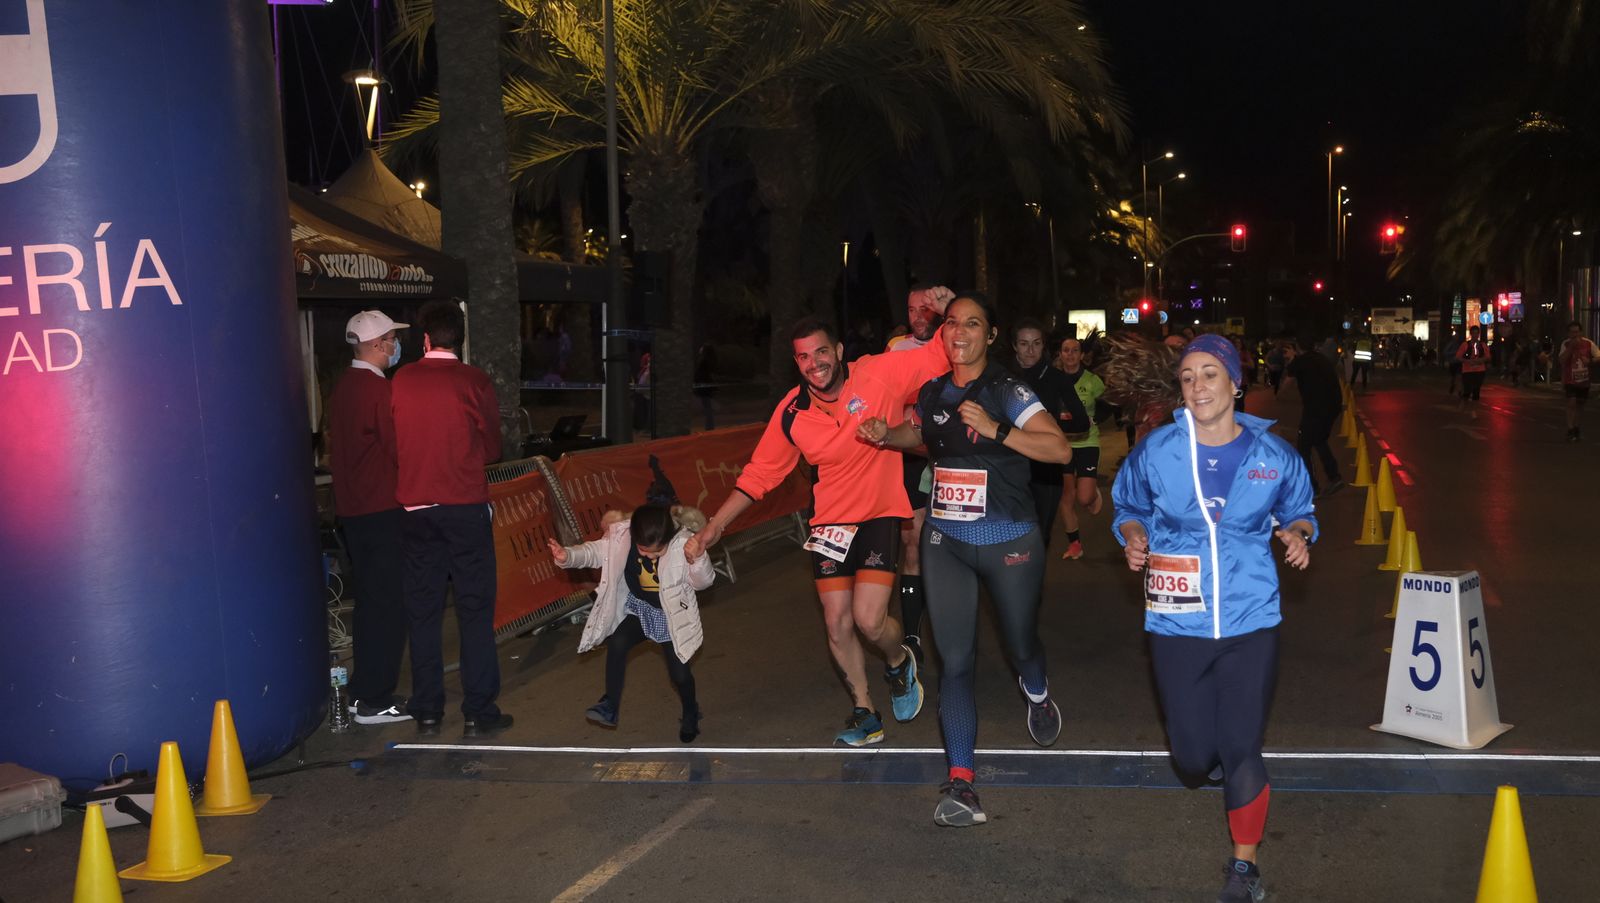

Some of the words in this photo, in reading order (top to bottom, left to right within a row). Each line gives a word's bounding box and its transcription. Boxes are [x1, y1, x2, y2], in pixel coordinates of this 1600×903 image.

[938, 486, 977, 502] 3037
[1149, 573, 1189, 593] 3036
[1403, 578, 1452, 594] MONDO
[1459, 576, 1480, 593] MONDO
[1409, 620, 1442, 692] 5
[1468, 617, 1485, 689] 5
